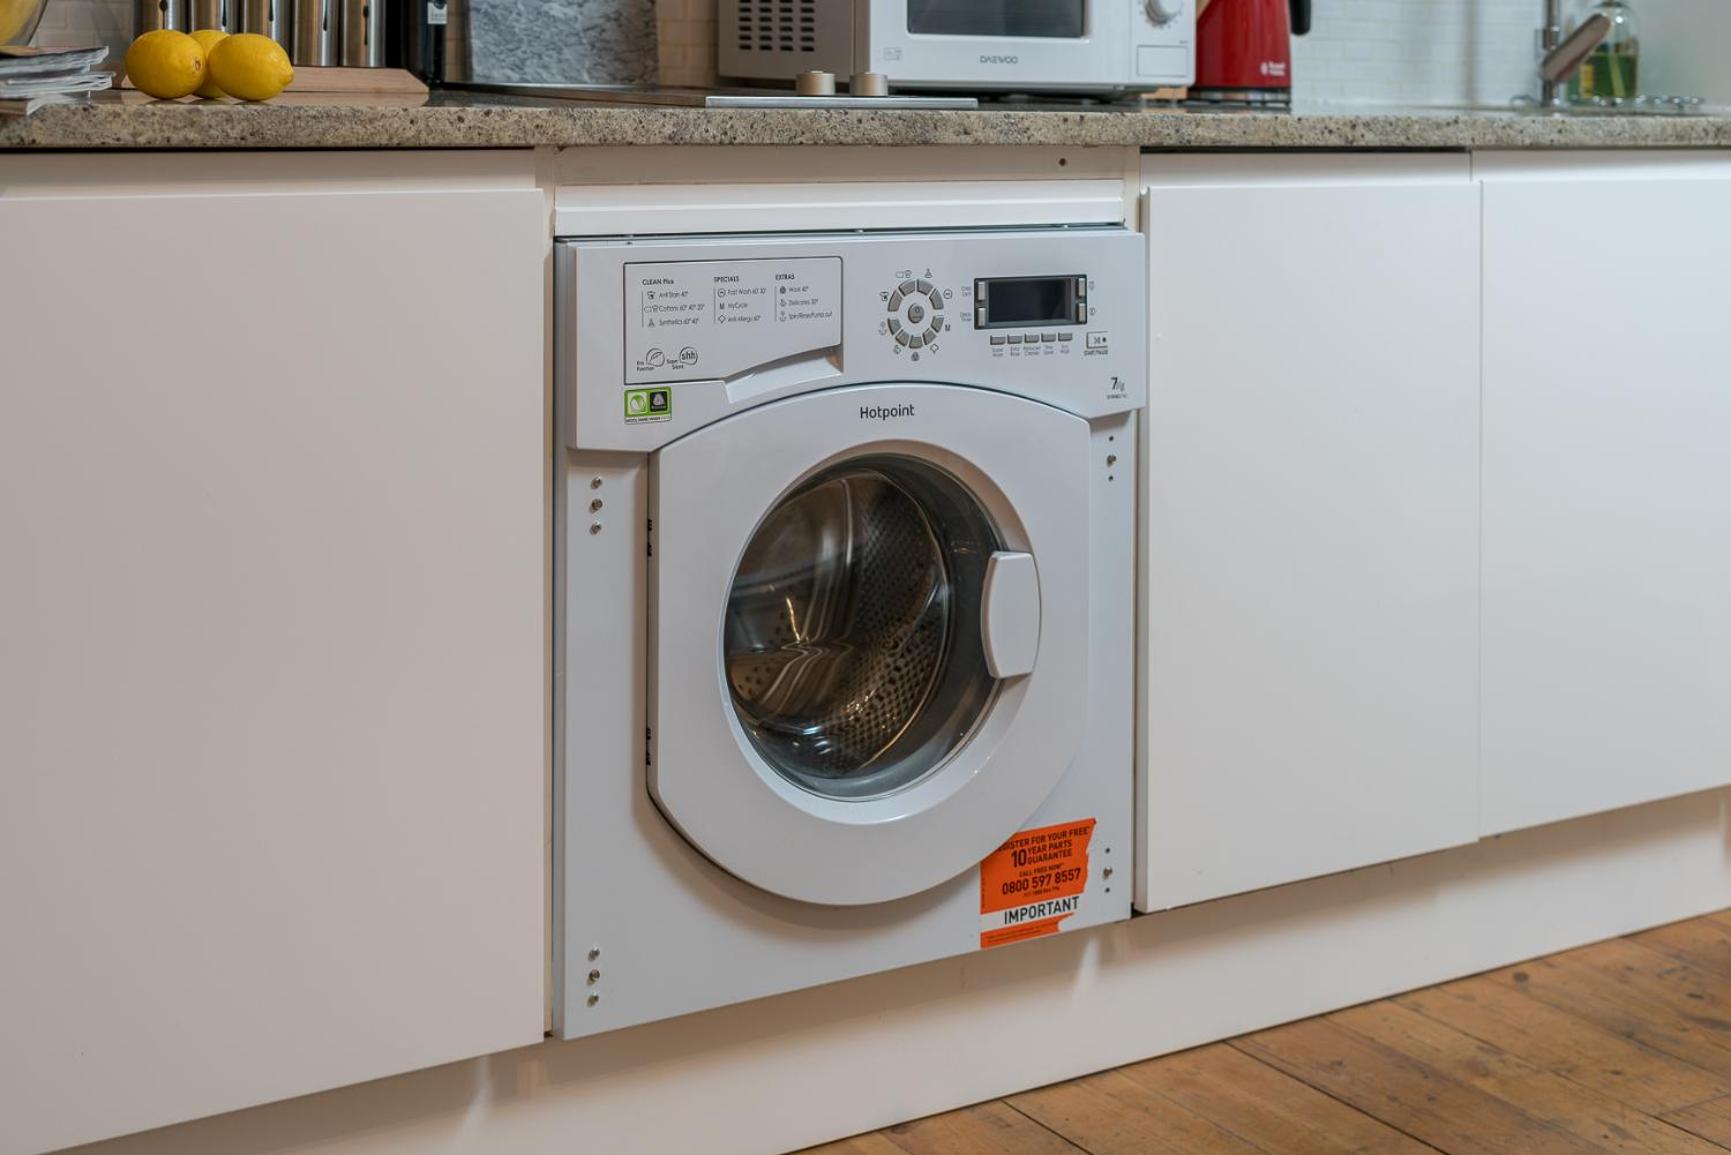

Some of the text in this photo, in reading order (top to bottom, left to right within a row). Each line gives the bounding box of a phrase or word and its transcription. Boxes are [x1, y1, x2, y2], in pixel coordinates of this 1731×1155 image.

[979, 56, 1018, 64] DAEWOO
[775, 273, 795, 281] EXTRAS
[682, 351, 696, 361] shh
[860, 403, 915, 421] Hotpoint
[1030, 834, 1046, 844] FOR
[1048, 830, 1067, 841] YOUR
[1027, 839, 1073, 855] YEAR PARTS
[1011, 848, 1027, 868] 10
[1027, 848, 1073, 865] GUARANTEE
[1002, 878, 1029, 895] 0800
[1032, 873, 1052, 889] 597
[1055, 867, 1081, 884] 8557
[1004, 895, 1080, 925] IMPORTANT
